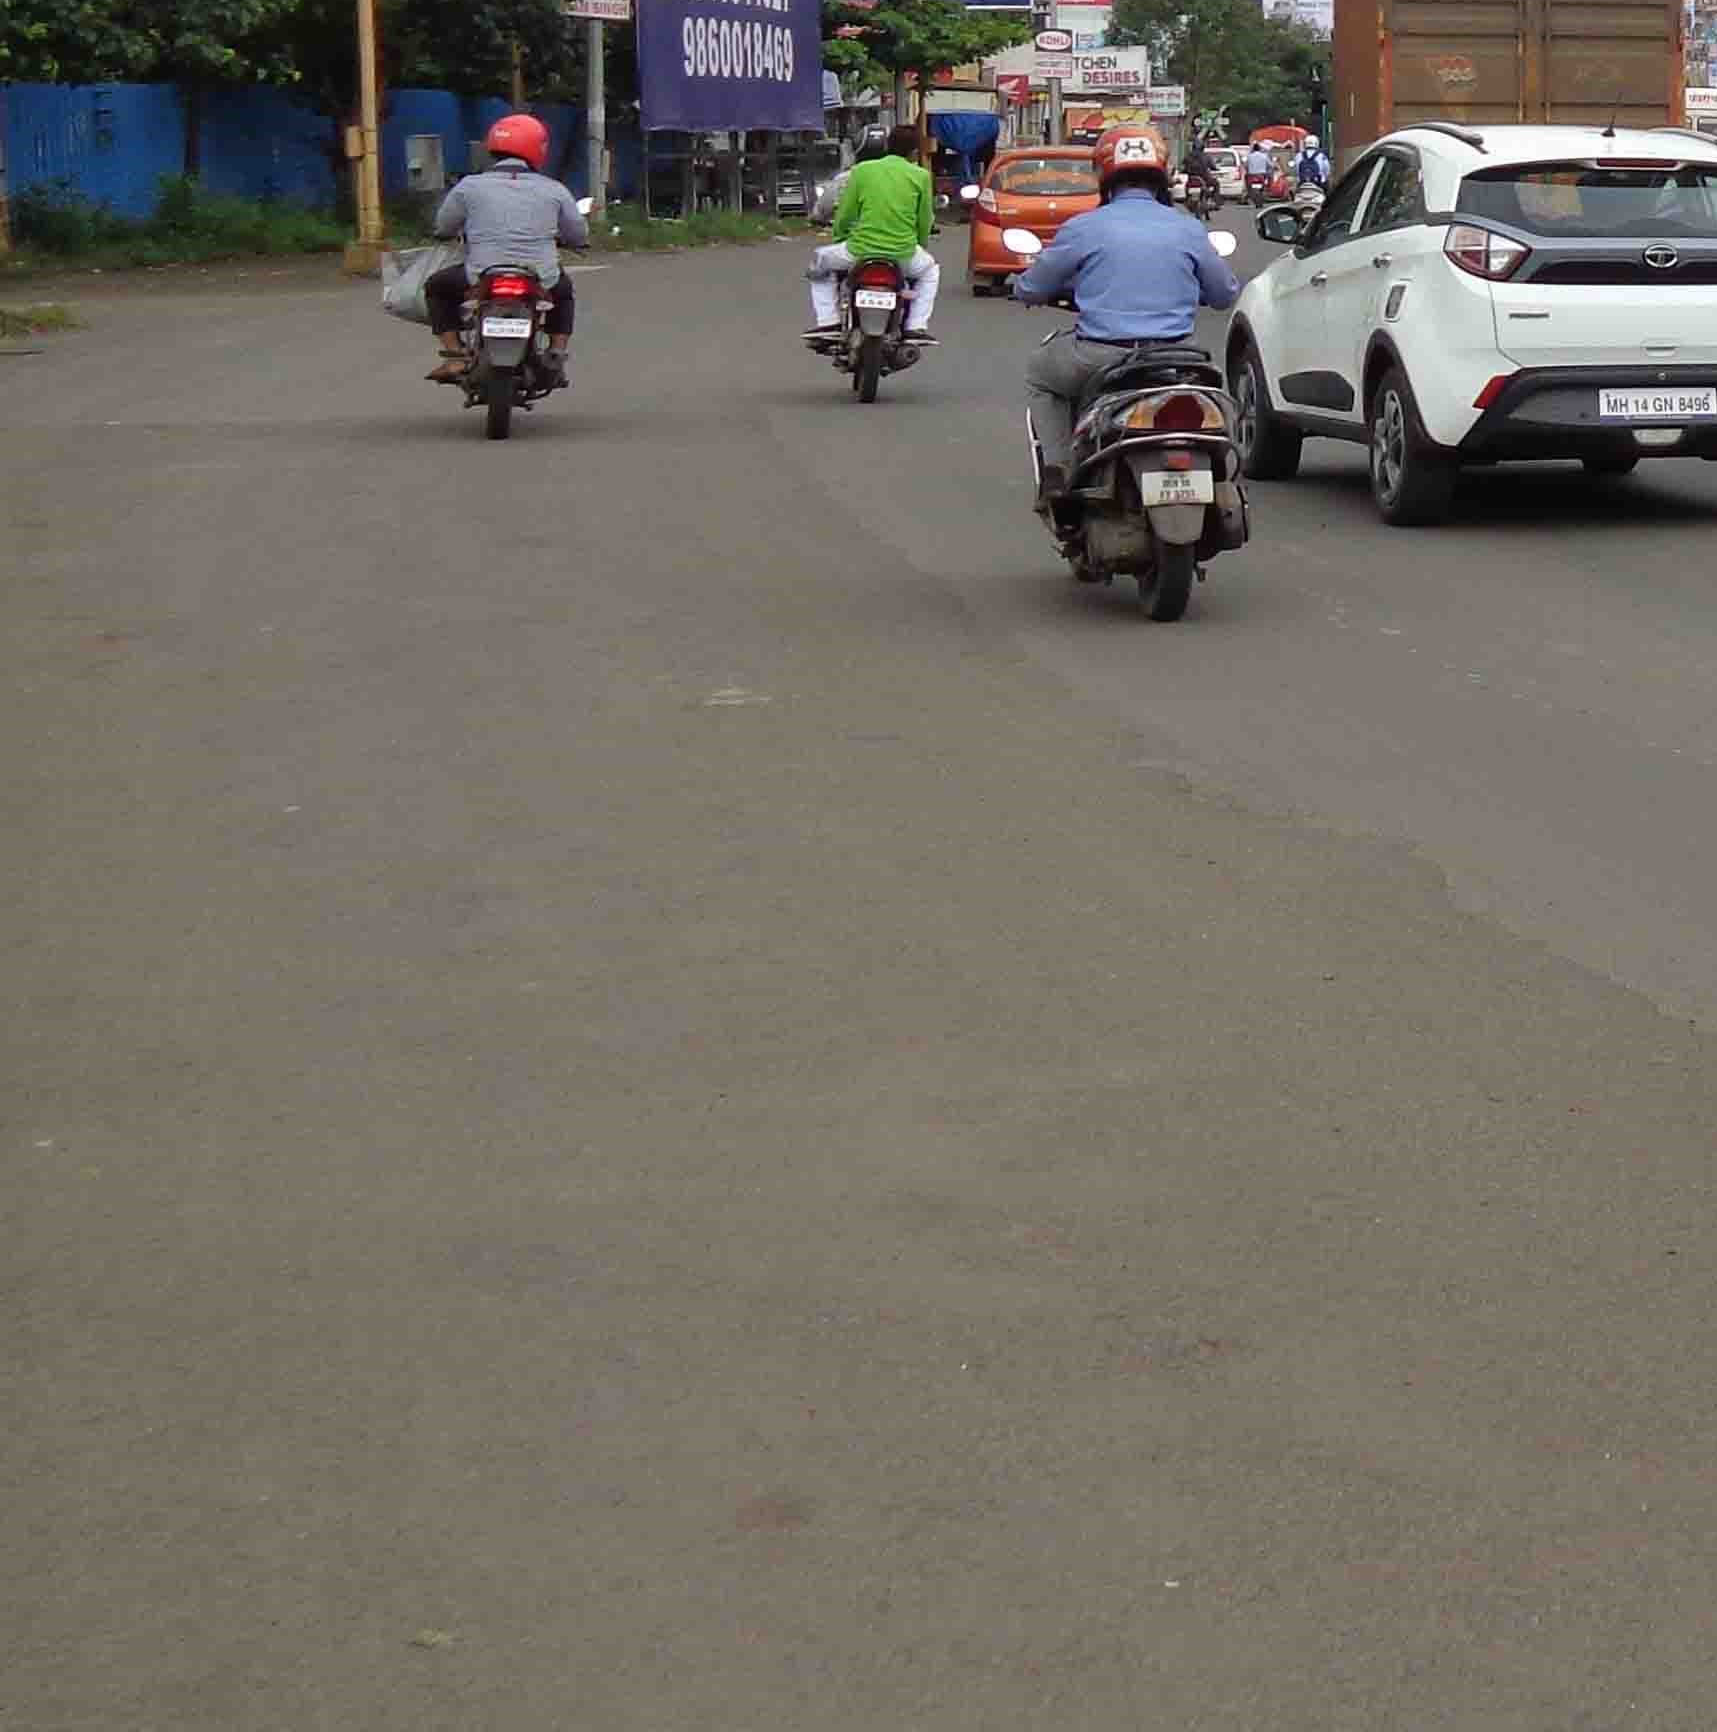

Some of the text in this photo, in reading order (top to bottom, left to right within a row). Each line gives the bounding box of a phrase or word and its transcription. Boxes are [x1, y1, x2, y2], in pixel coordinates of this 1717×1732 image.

[682, 17, 793, 83] 9860018469
[1072, 56, 1117, 69] TCHEN
[1082, 70, 1141, 85] DESIRES
[1607, 398, 1710, 412] MH 14 GN 8496
